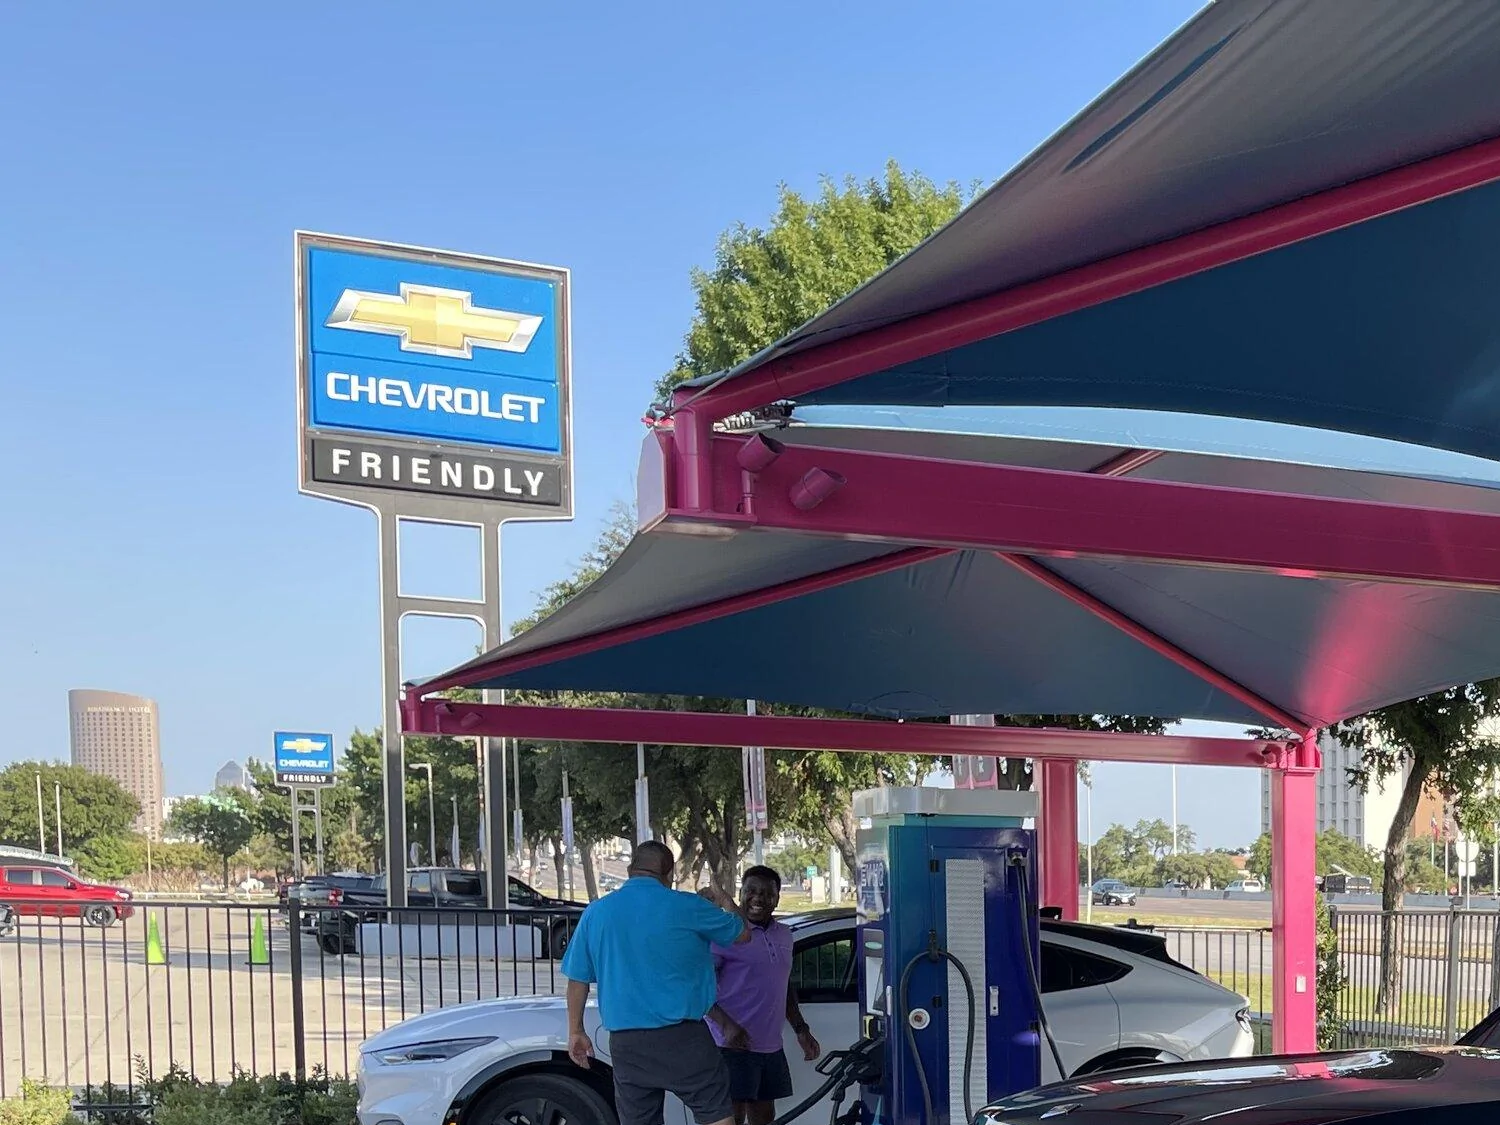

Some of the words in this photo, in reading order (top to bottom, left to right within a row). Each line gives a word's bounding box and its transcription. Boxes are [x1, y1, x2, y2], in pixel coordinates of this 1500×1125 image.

[326, 372, 545, 423] CHEVROLET
[332, 448, 544, 496] FRIENDLY
[279, 759, 329, 768] CHEVROLET
[283, 774, 326, 783] FRIENDLY
